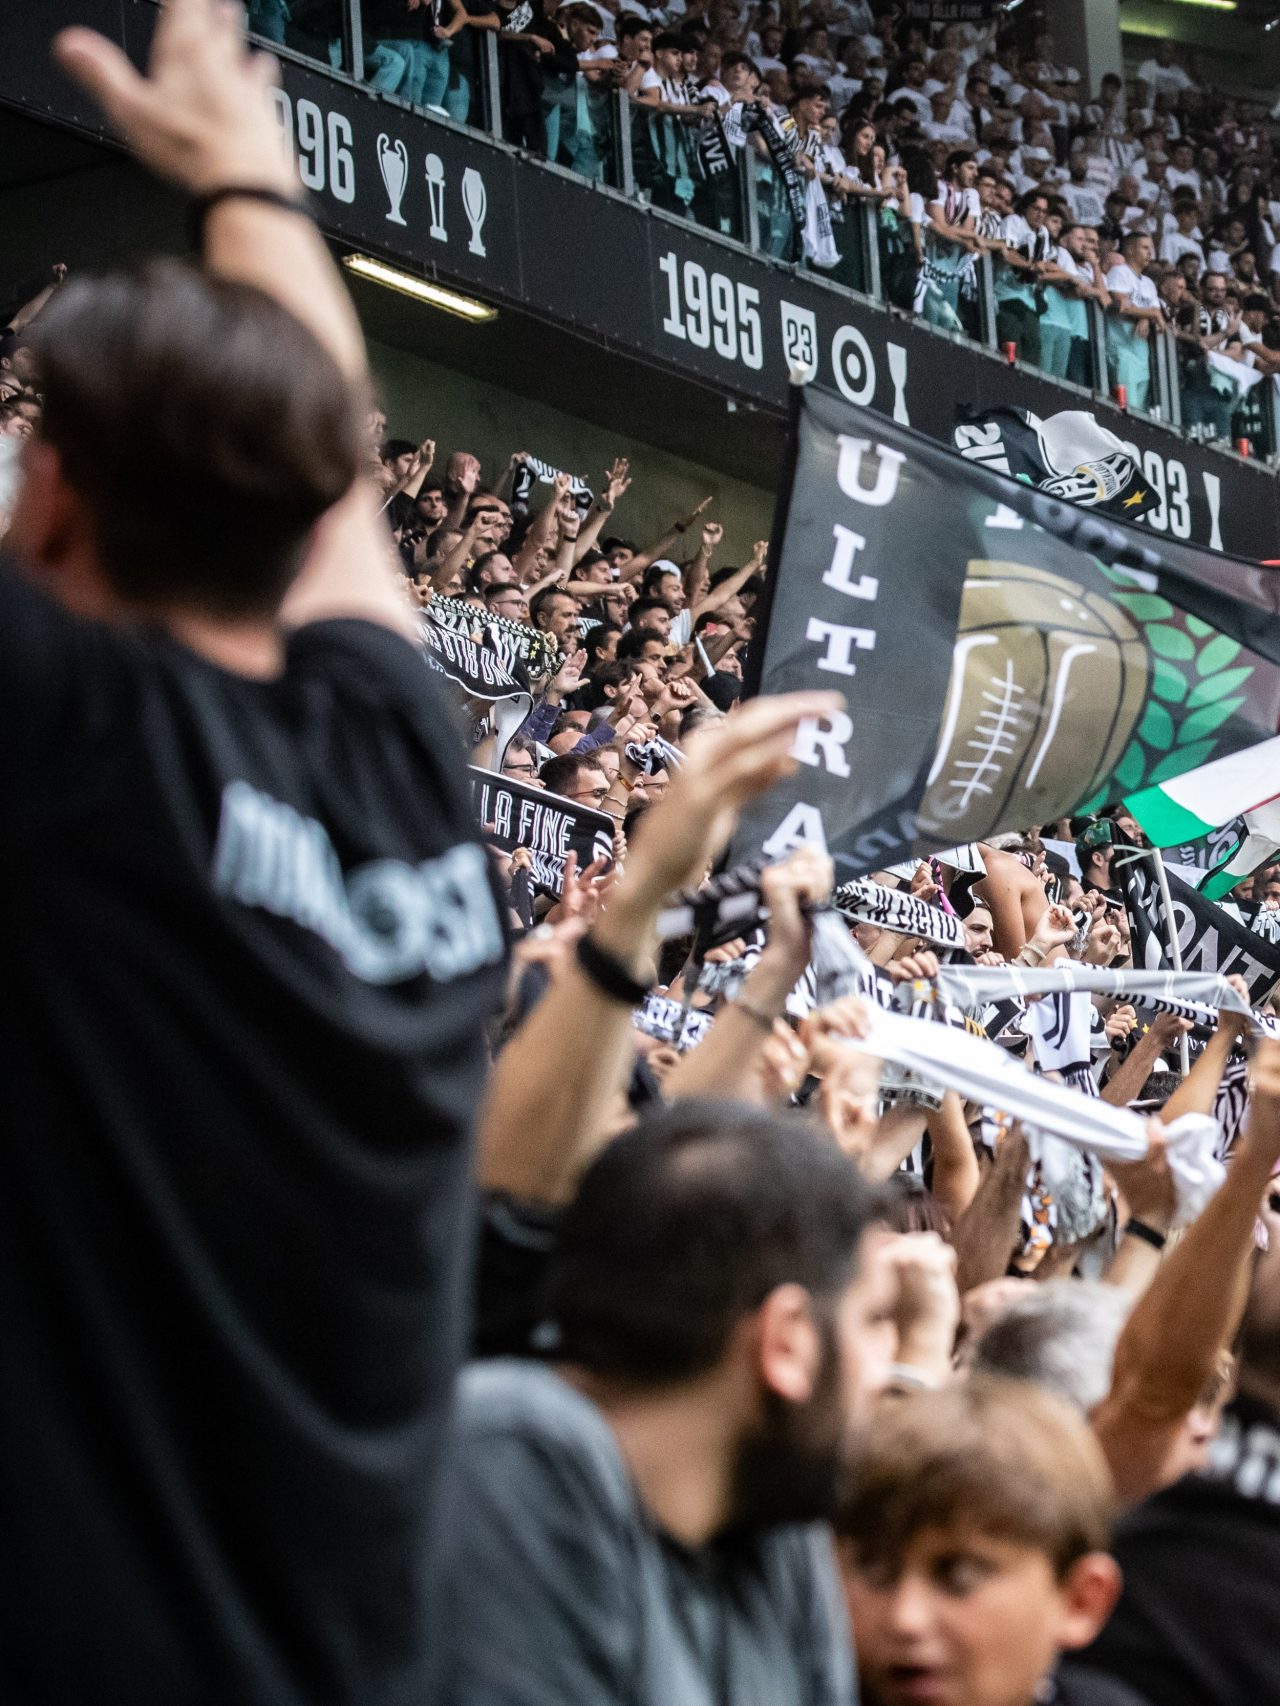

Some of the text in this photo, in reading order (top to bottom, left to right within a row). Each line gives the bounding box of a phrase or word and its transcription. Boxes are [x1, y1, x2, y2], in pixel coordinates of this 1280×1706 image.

[659, 252, 764, 371] 1995
[787, 318, 813, 366] 23
[517, 799, 577, 859] FINE
